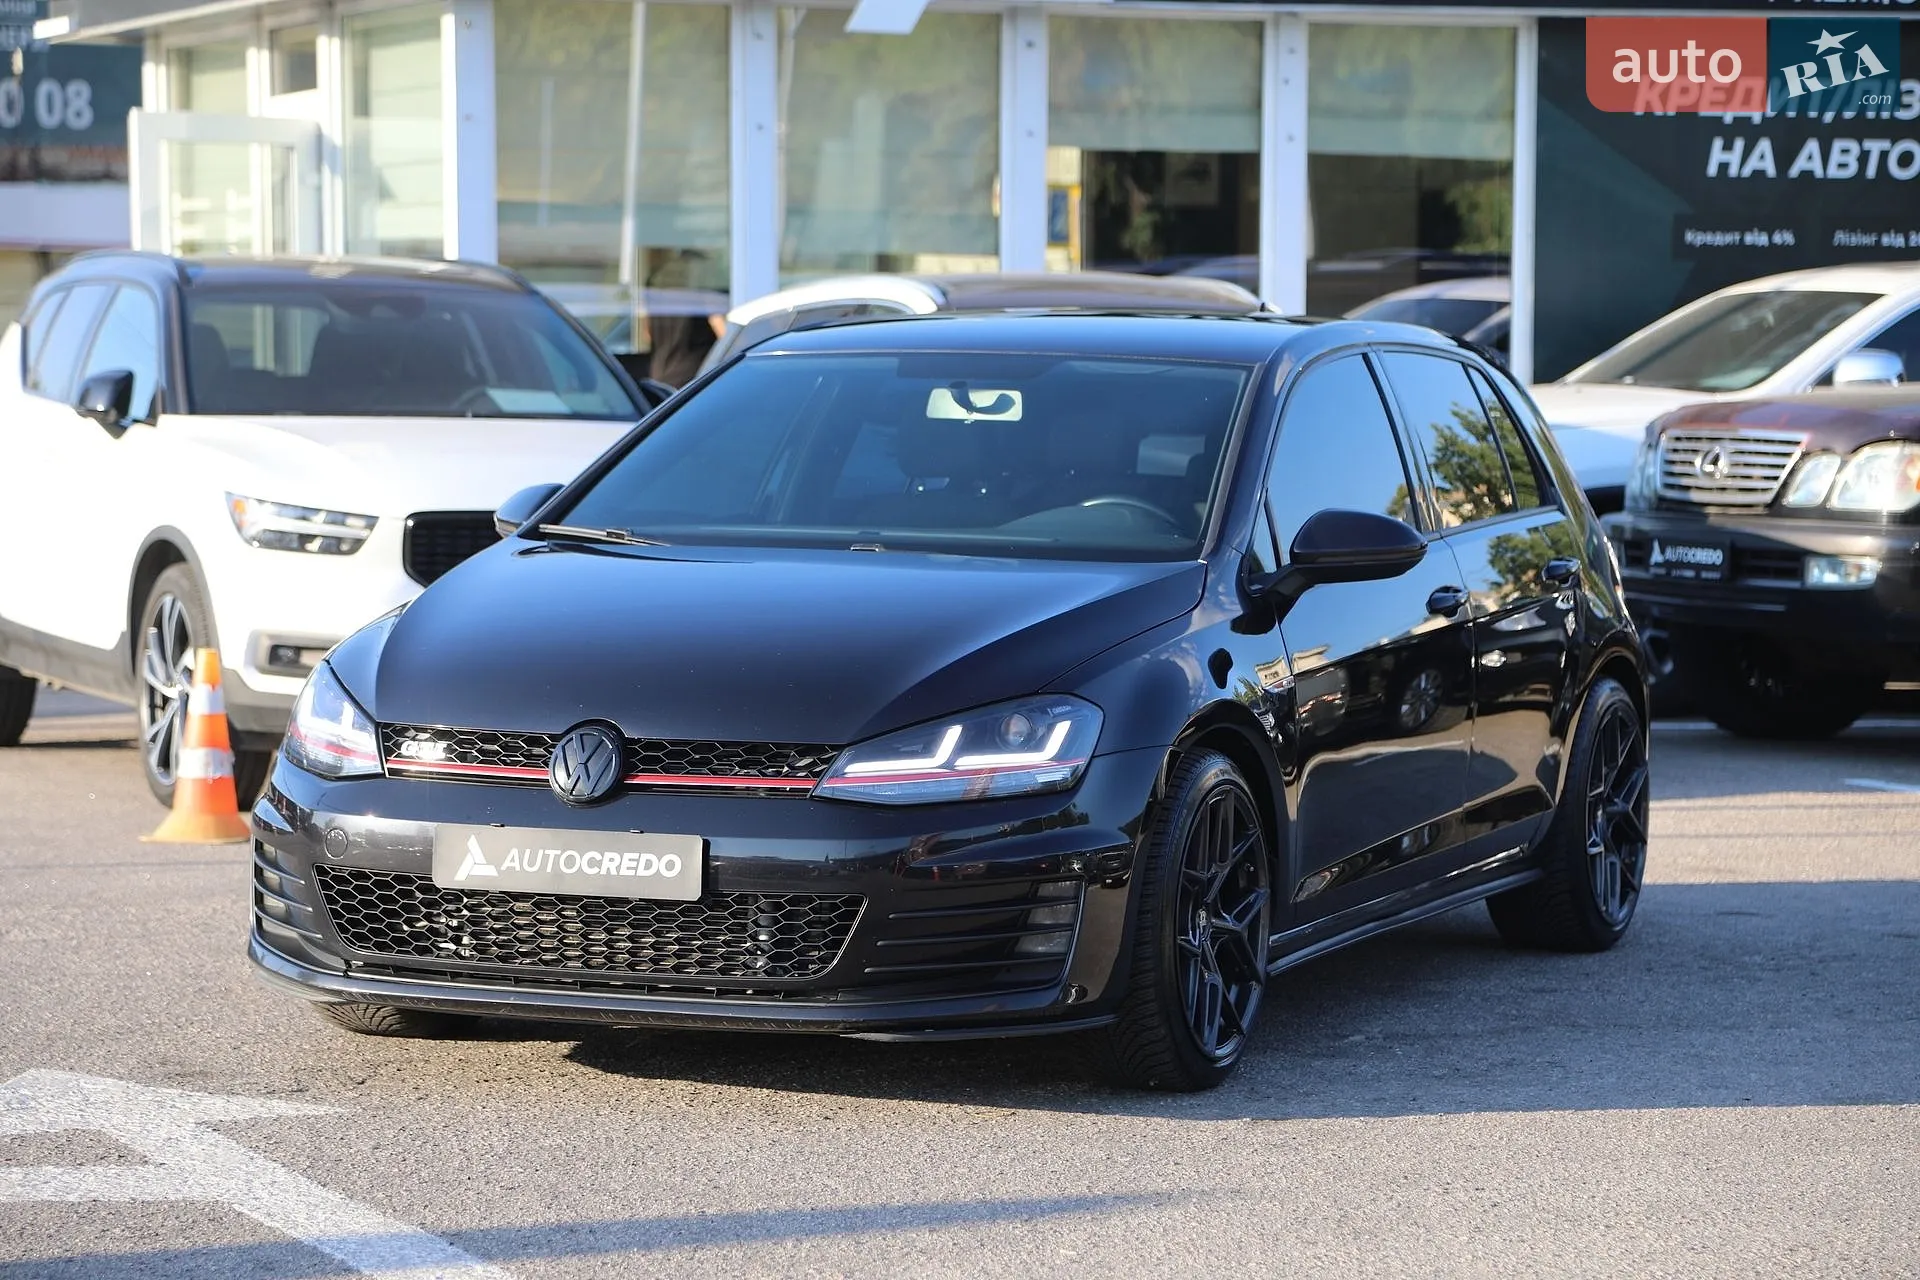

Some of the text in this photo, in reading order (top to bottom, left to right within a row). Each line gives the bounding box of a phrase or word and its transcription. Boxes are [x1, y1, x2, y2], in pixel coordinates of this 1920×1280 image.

[34, 78, 94, 130] 08
[1706, 136, 1920, 180] НА АВТО
[500, 847, 682, 878] AUTOCREDO
